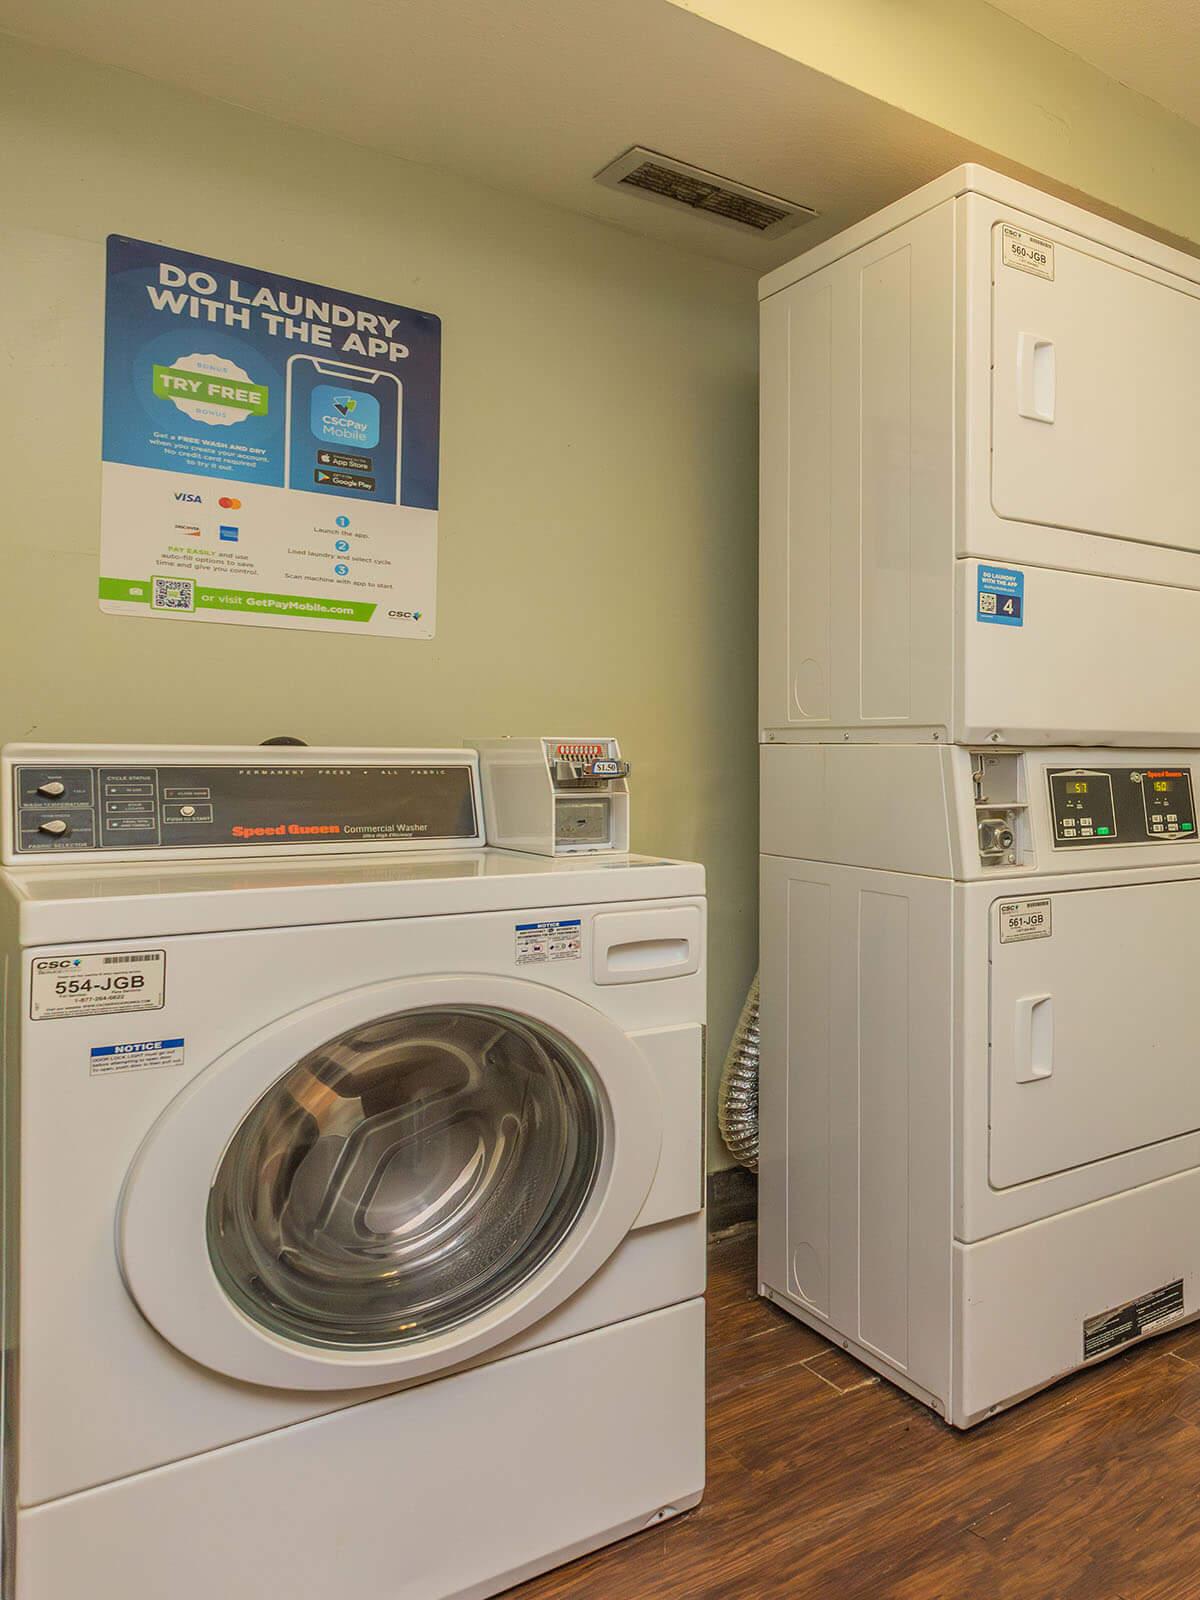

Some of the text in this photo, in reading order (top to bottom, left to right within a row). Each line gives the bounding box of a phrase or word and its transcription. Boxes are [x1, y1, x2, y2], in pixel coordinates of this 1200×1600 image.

[1011, 244, 1047, 263] 560-JGB
[159, 262, 400, 338] DO LAUNDRY
[146, 285, 409, 362] WITH THE APP
[159, 374, 261, 404] TRY FREE
[322, 415, 368, 431] CSCPay
[322, 424, 366, 441] Mobile
[174, 492, 202, 503] VISA
[340, 518, 345, 526] 1
[313, 527, 339, 535] Launch
[338, 541, 346, 550] 2
[338, 566, 346, 574] 3
[218, 595, 242, 604] visit
[246, 597, 353, 614] GetPayMobile.com
[1002, 599, 1013, 614] 4
[388, 610, 411, 618] CSC
[232, 822, 428, 838] Speed Queen Commercial Washer
[1008, 914, 1043, 927] 561-JGB
[37, 960, 71, 969] CSC
[55, 975, 144, 994] 554-JGB
[114, 1042, 162, 1053] NOTICE
